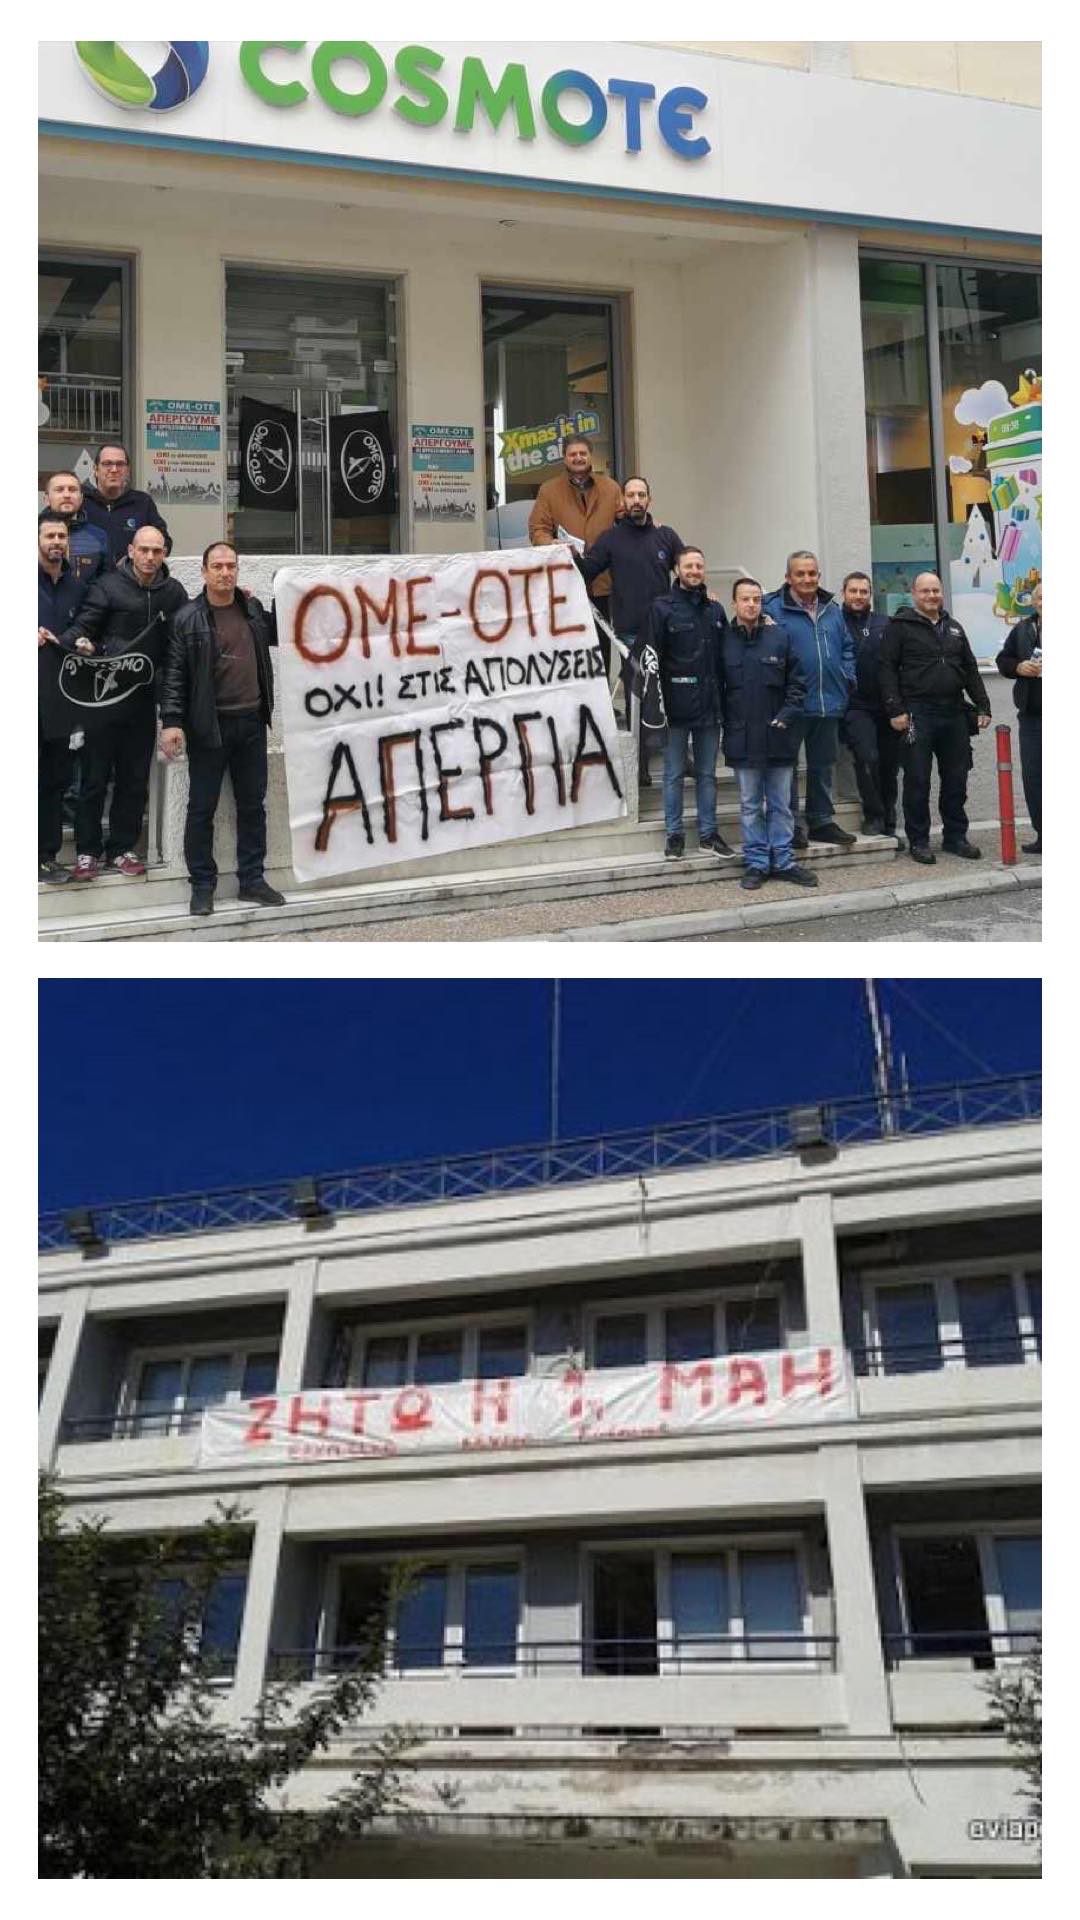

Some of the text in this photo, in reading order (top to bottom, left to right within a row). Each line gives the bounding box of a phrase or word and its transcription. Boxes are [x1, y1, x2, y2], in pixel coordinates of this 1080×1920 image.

[240, 41, 711, 160] COSMOTE
[504, 412, 597, 451] Xmas is in
[507, 437, 566, 471] the ai
[294, 563, 586, 664] ΟΜΕ-ΟΤΕ
[304, 674, 384, 718] ΟΧΙ!
[398, 667, 456, 700] ΣΤΙΣ
[464, 646, 608, 696] ΑΠΟΛΥΣΕΙΣ
[314, 704, 623, 852] ΑΠΕΡΓΙΑ
[244, 1386, 433, 1443] ΖΗΤΩ
[472, 1379, 511, 1424] Η
[660, 1349, 832, 1410] ΜΑΗ
